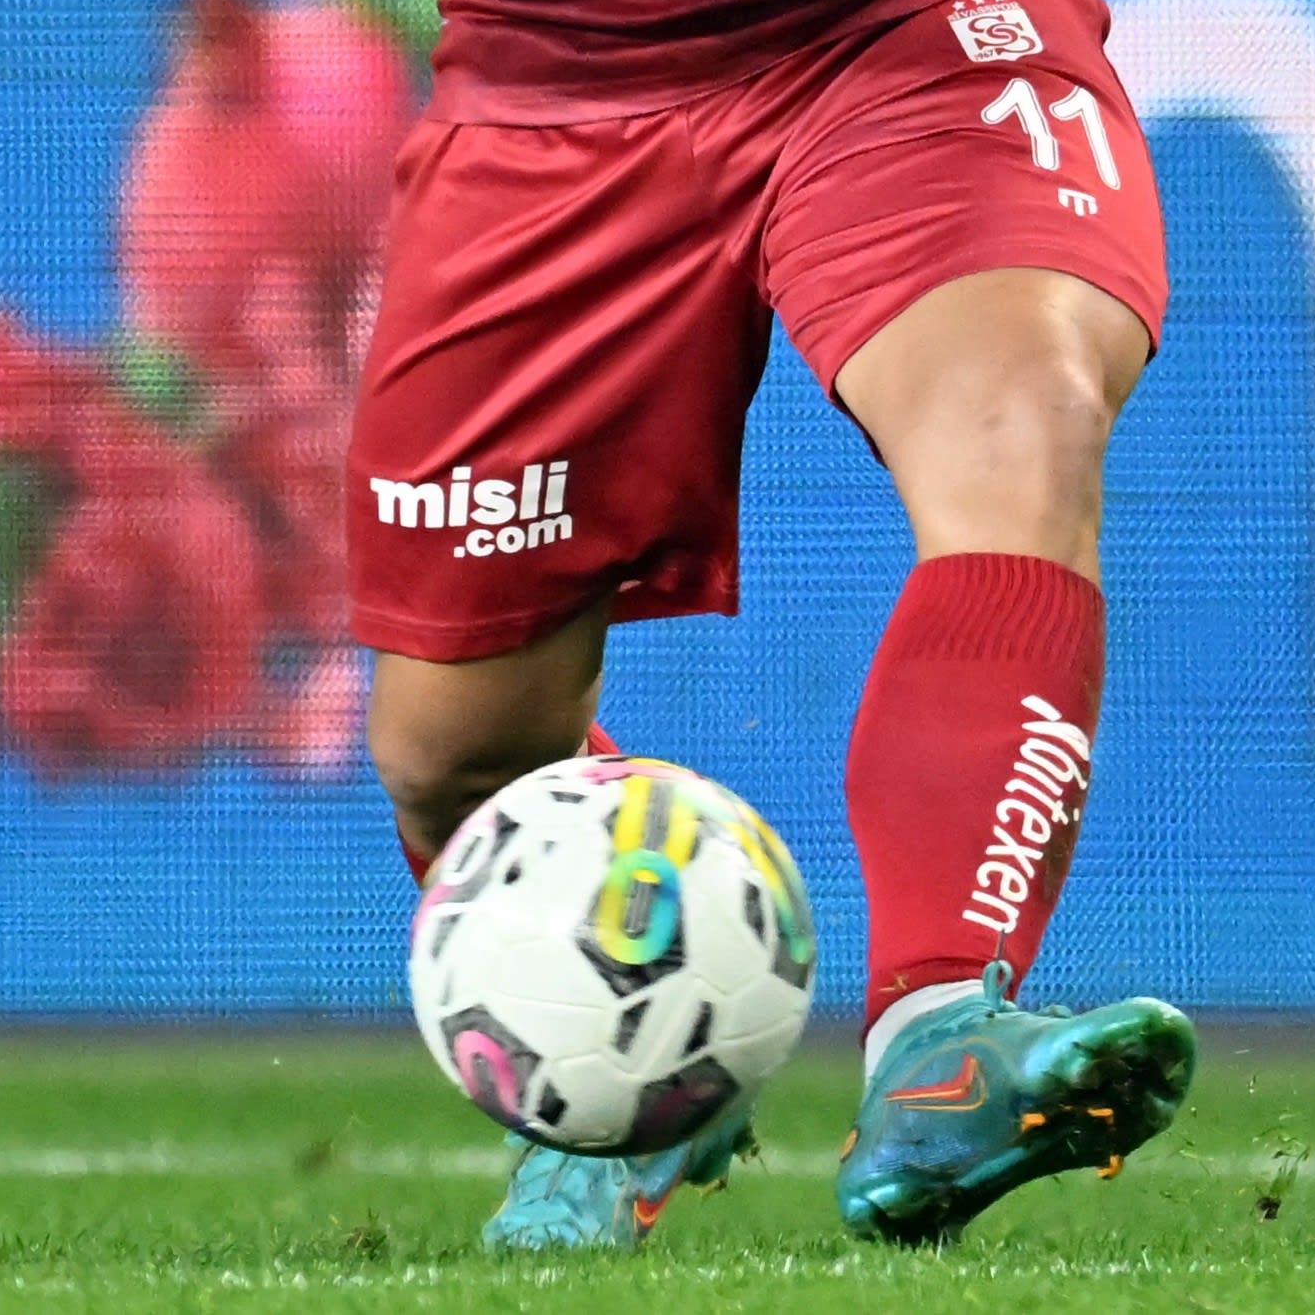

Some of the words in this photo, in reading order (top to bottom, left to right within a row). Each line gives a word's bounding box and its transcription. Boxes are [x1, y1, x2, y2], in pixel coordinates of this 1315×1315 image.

[980, 77, 1121, 190] 11
[370, 460, 569, 529] misli
[453, 514, 573, 558] .com
[961, 736, 1088, 935] bitexen
